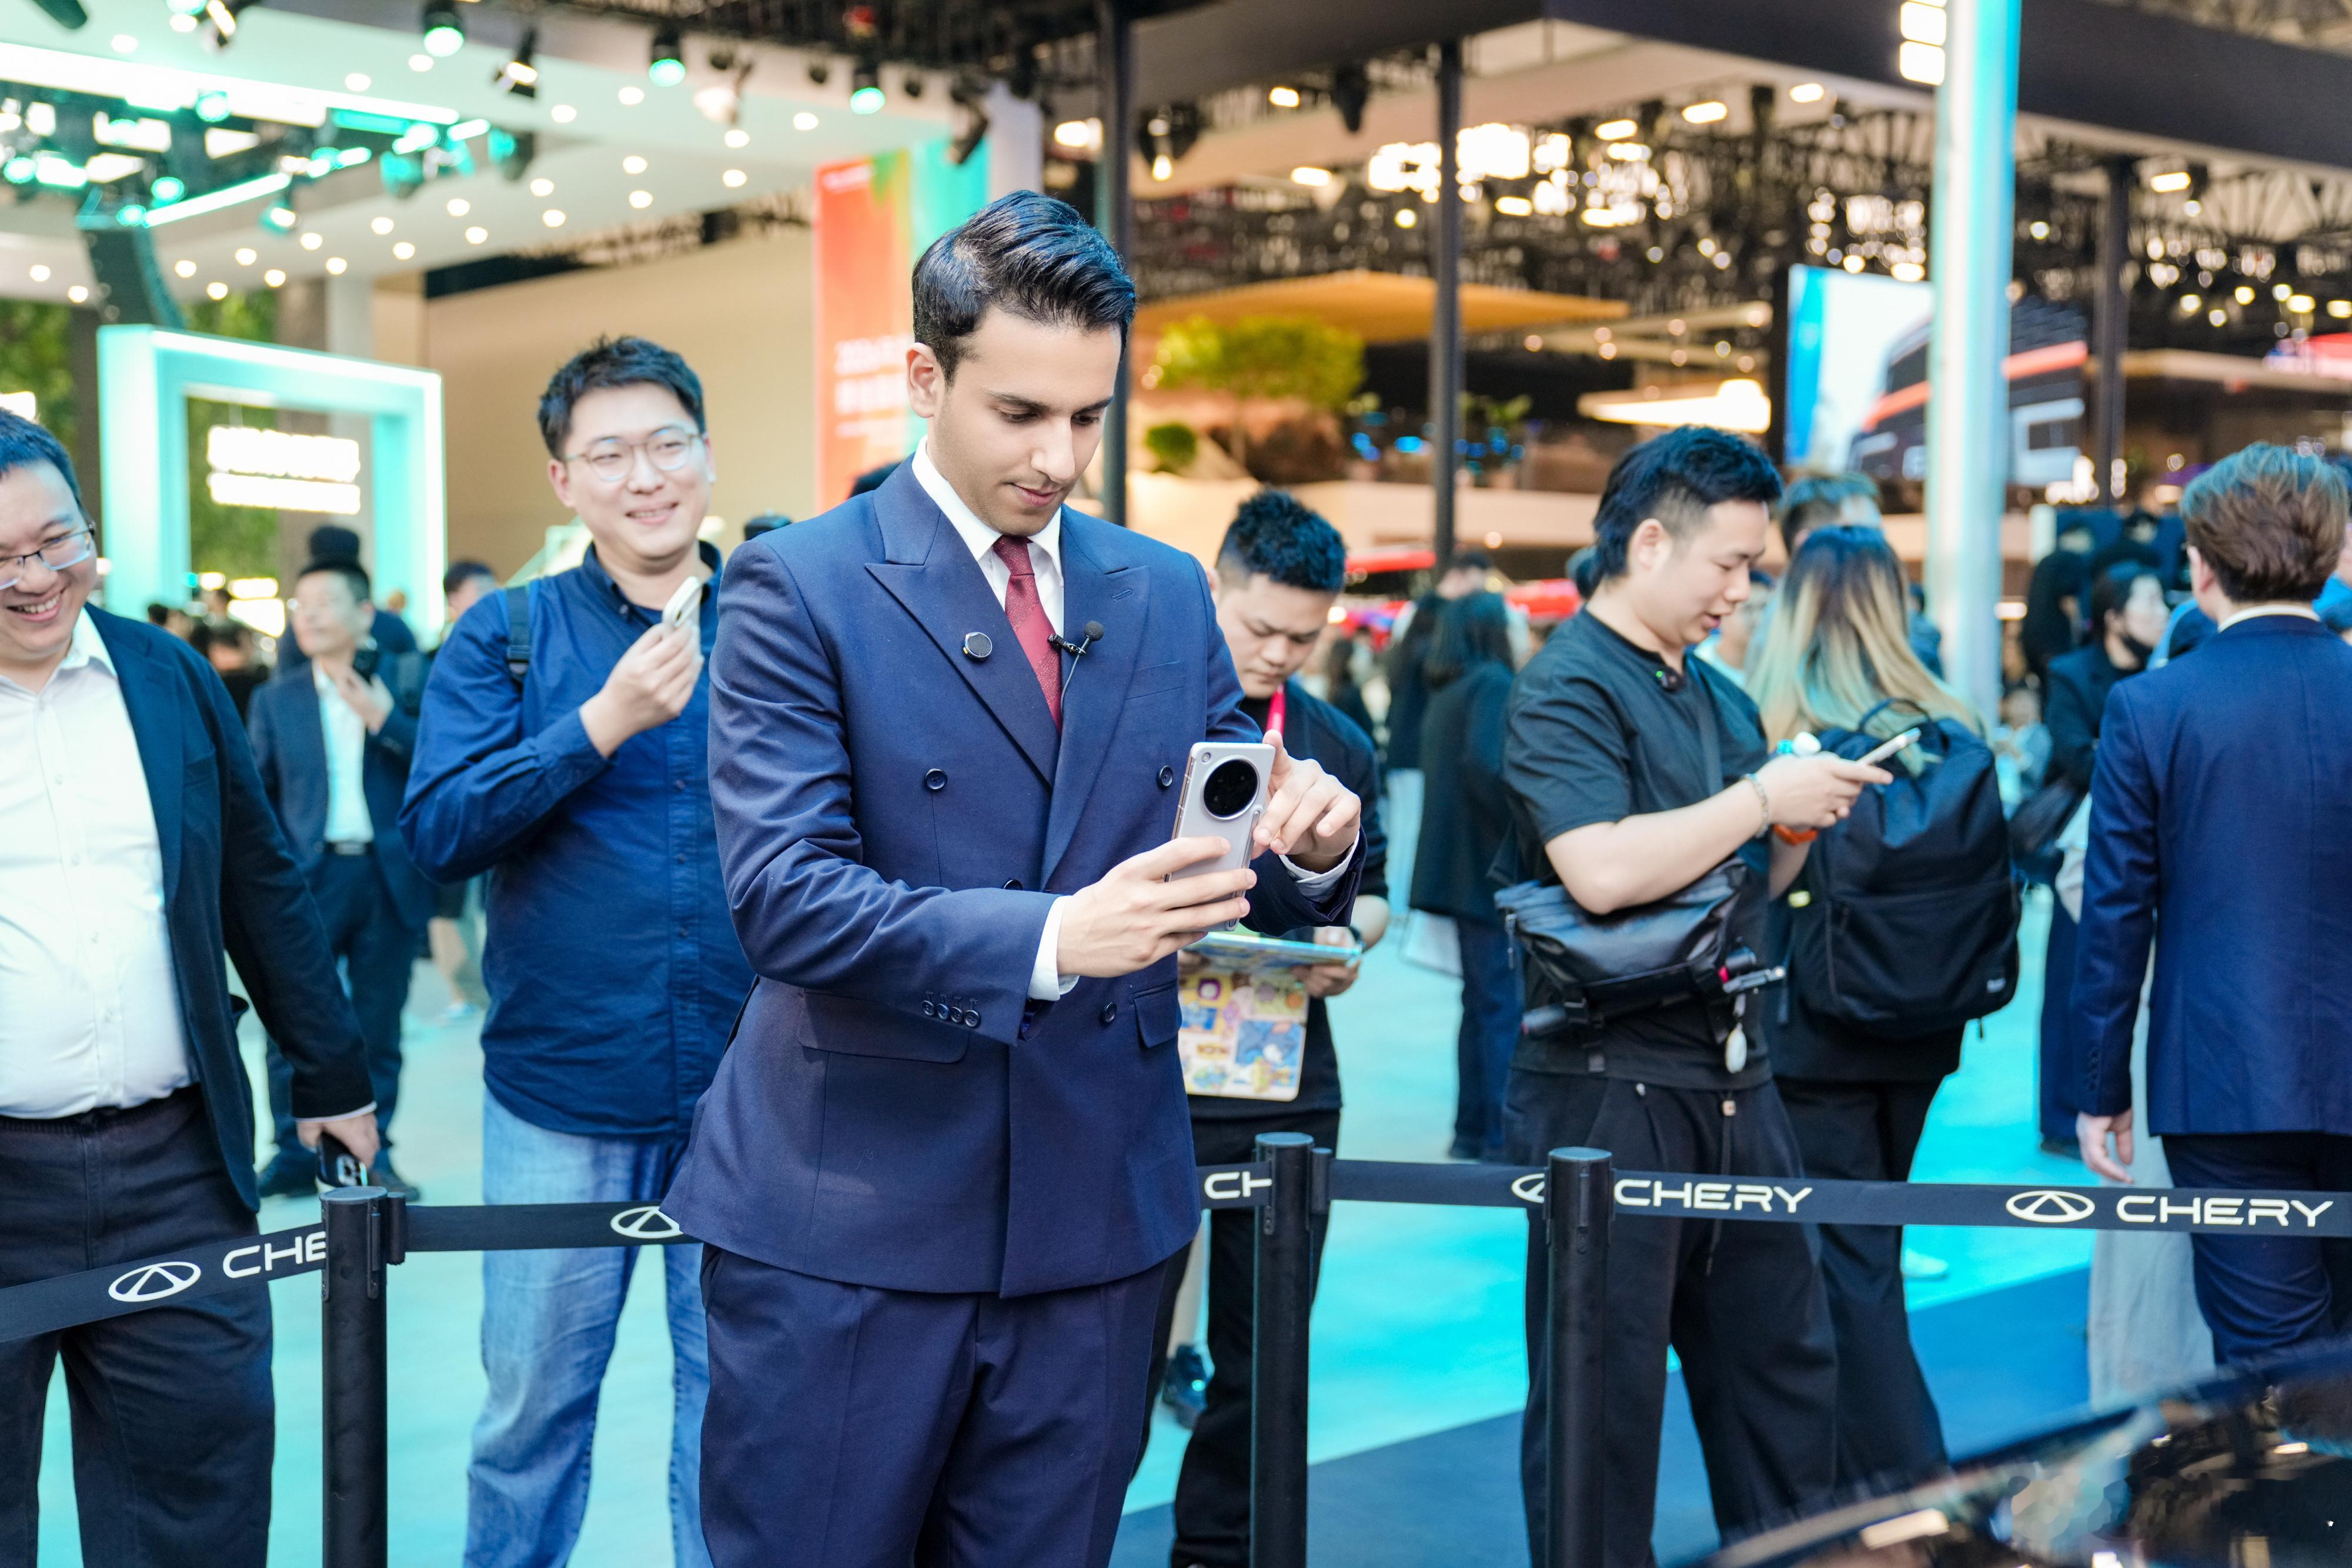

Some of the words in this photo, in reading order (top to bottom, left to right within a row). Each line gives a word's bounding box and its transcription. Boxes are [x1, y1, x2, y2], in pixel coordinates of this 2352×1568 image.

[1204, 1171, 1272, 1199] CH
[1614, 1179, 1813, 1213] CHERY
[2116, 1195, 2334, 1227] CHERY
[222, 1231, 326, 1278] CHE
